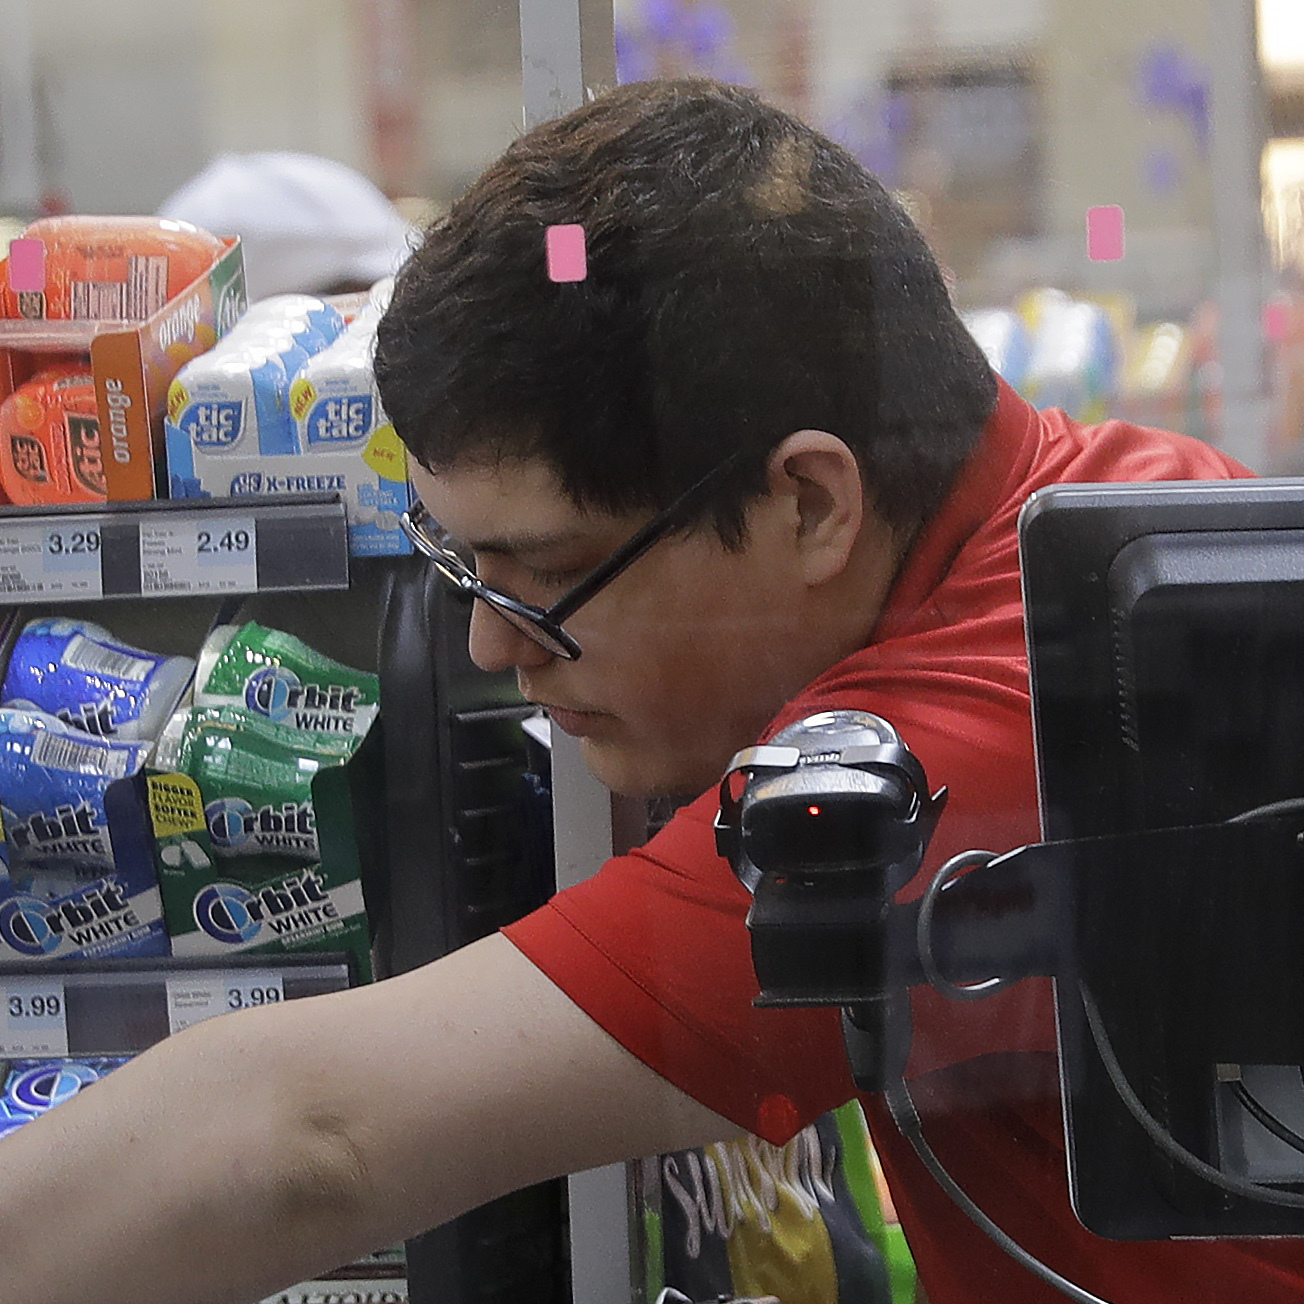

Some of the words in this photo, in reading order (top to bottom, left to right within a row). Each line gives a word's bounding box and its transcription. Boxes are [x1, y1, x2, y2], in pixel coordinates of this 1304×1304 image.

[105, 377, 132, 464] orange
[197, 403, 235, 425] tic
[325, 398, 365, 420] tic
[188, 422, 234, 443] tac
[316, 417, 365, 438] tac
[48, 531, 101, 555] 3.29
[196, 529, 250, 553] 2.49
[295, 711, 354, 733] WHITE
[68, 910, 141, 947] WHITE
[267, 901, 338, 935] WHITE
[8, 995, 62, 1019] 3.99
[227, 987, 282, 1010] 3.99
